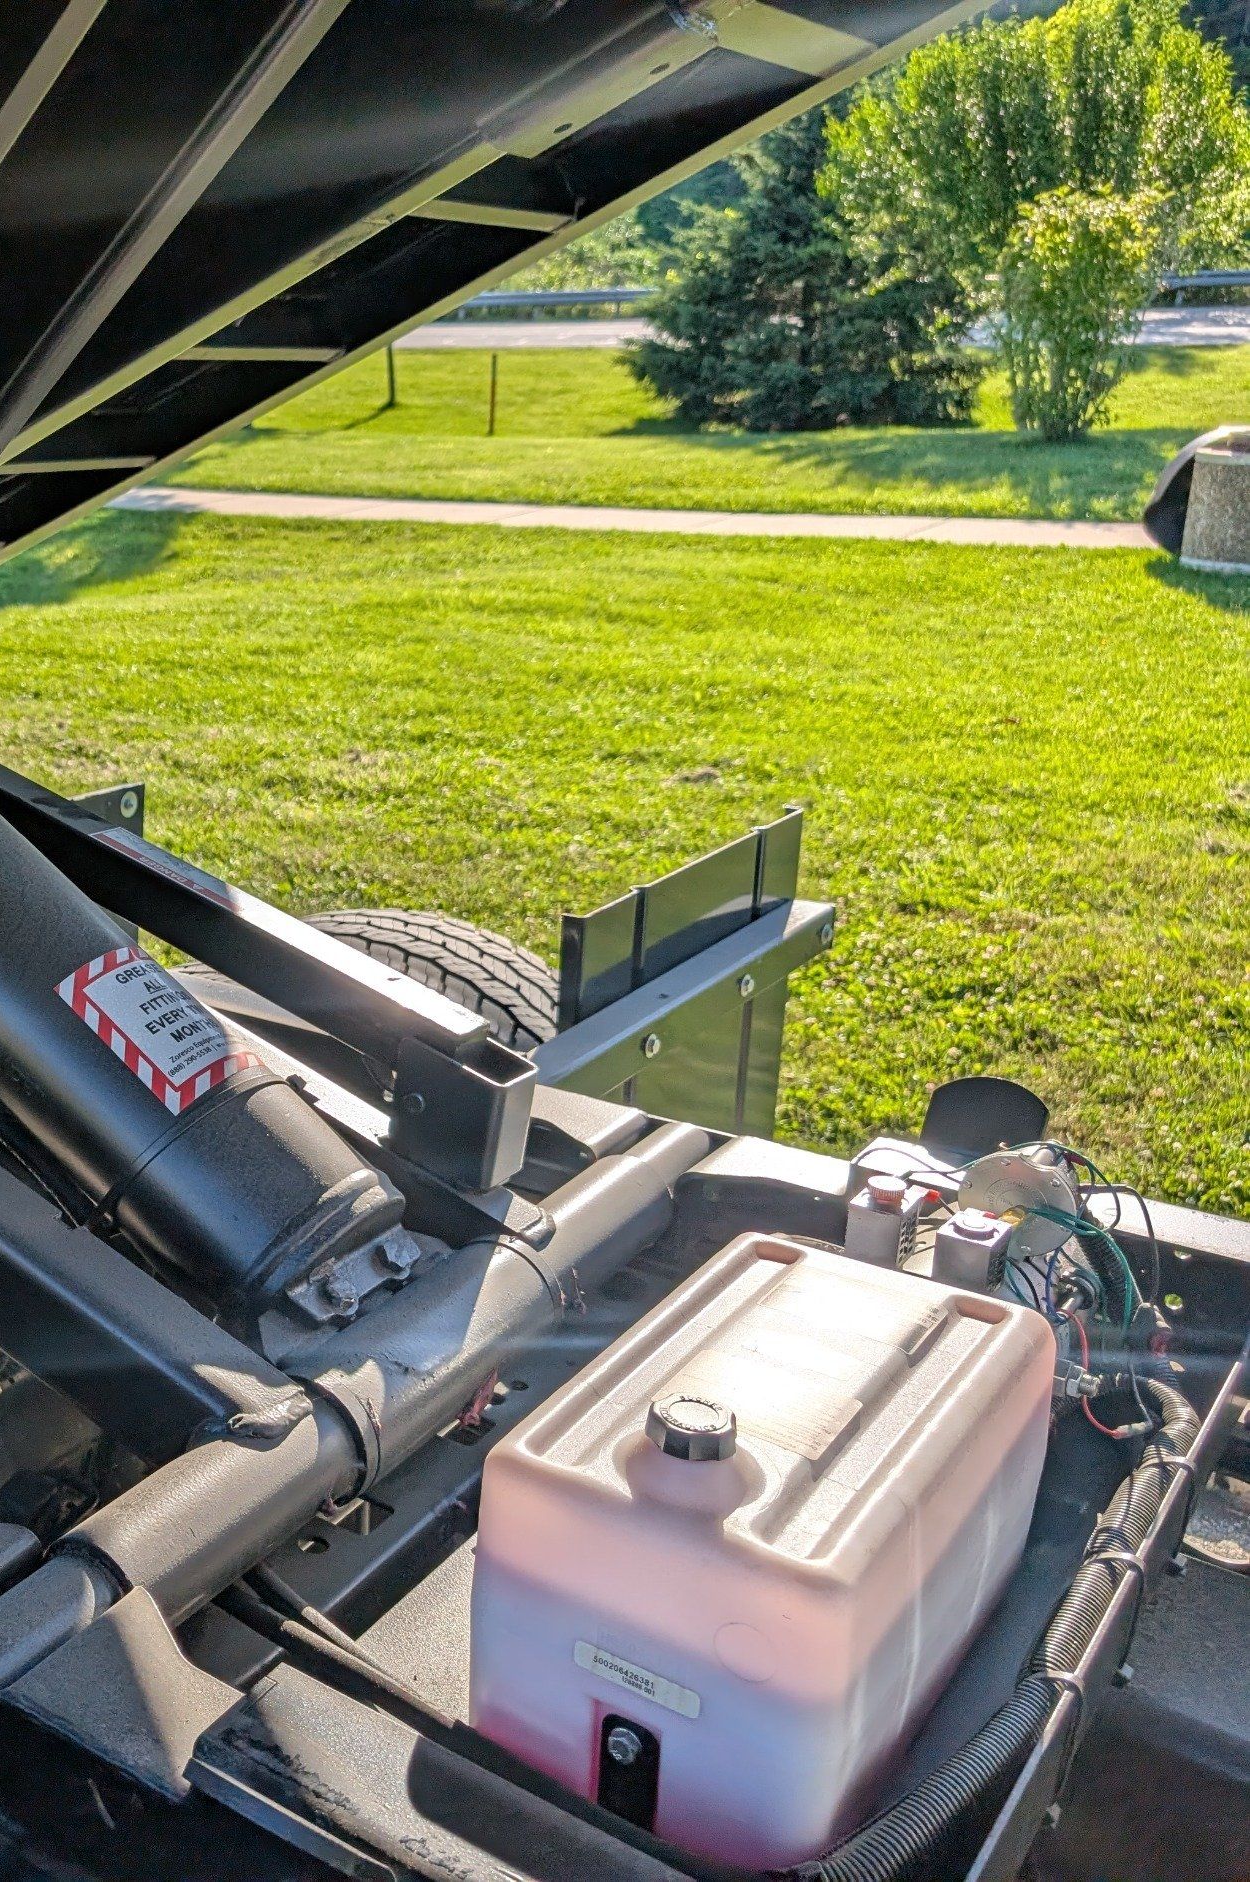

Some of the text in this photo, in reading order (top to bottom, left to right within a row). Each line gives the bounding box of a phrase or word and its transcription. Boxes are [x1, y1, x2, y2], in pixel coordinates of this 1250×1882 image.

[138, 856, 187, 884] DANGER
[144, 978, 168, 993] ALL
[145, 1007, 188, 1035] EVERY
